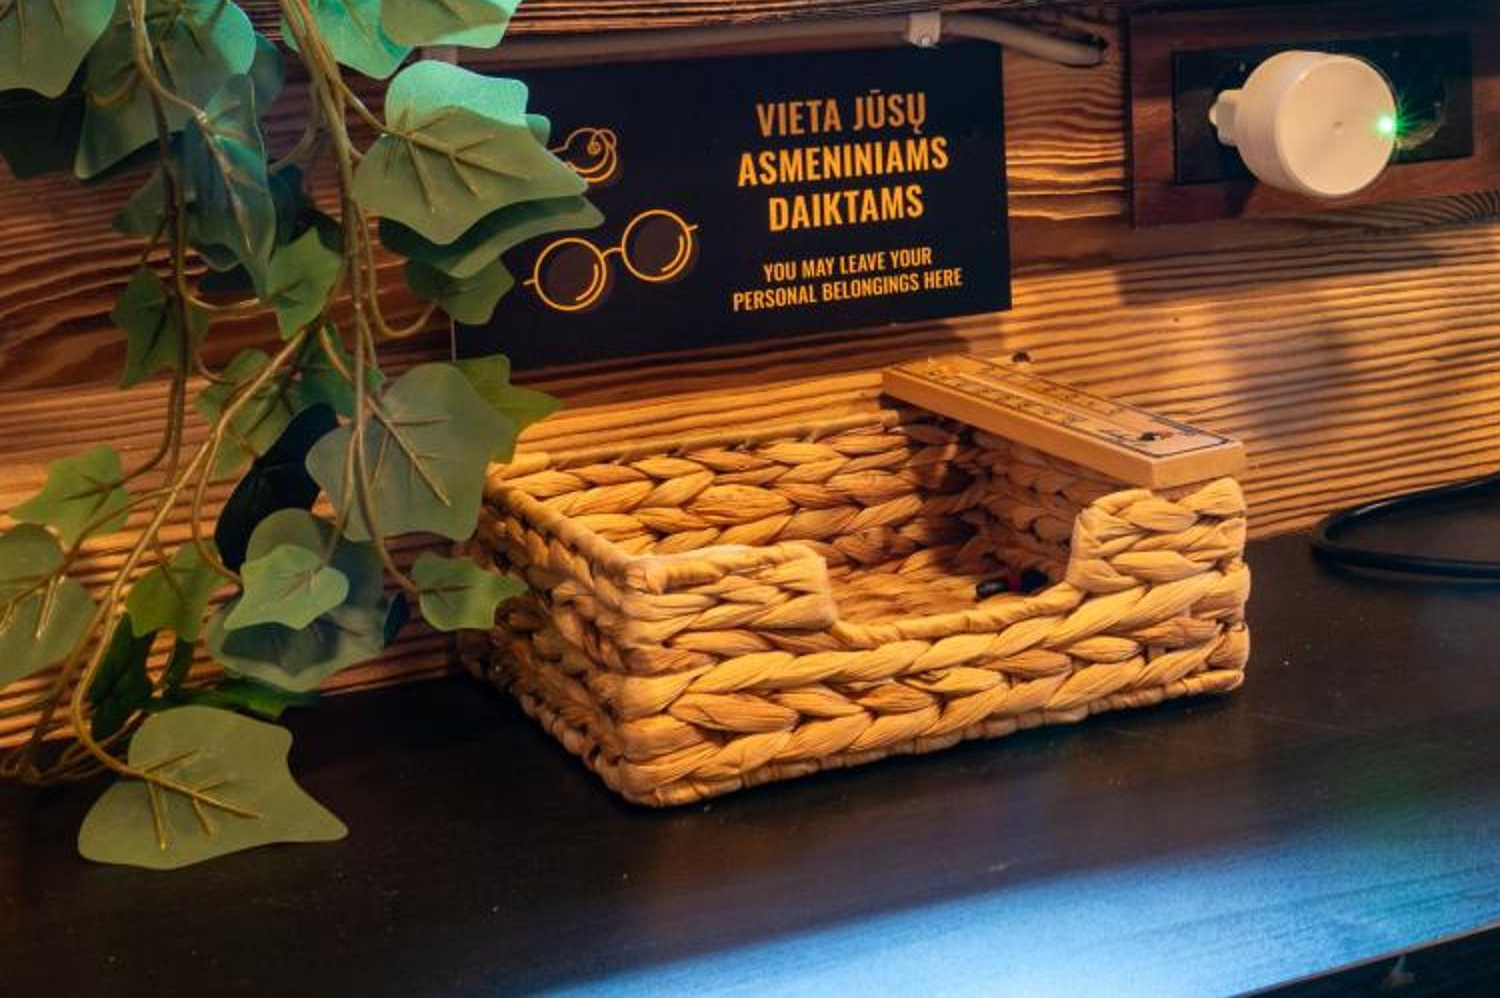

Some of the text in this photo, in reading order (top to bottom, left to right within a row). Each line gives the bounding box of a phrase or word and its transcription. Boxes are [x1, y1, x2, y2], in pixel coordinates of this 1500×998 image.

[756, 89, 926, 138] VIETA JŪSŲ
[737, 135, 949, 187] ASMENINIAMS
[767, 184, 924, 231] DAIKTAMS
[763, 246, 932, 283] YOU MAY LEAVE YOUR
[733, 267, 963, 312] PERSONAL BELONGINGS HERE
